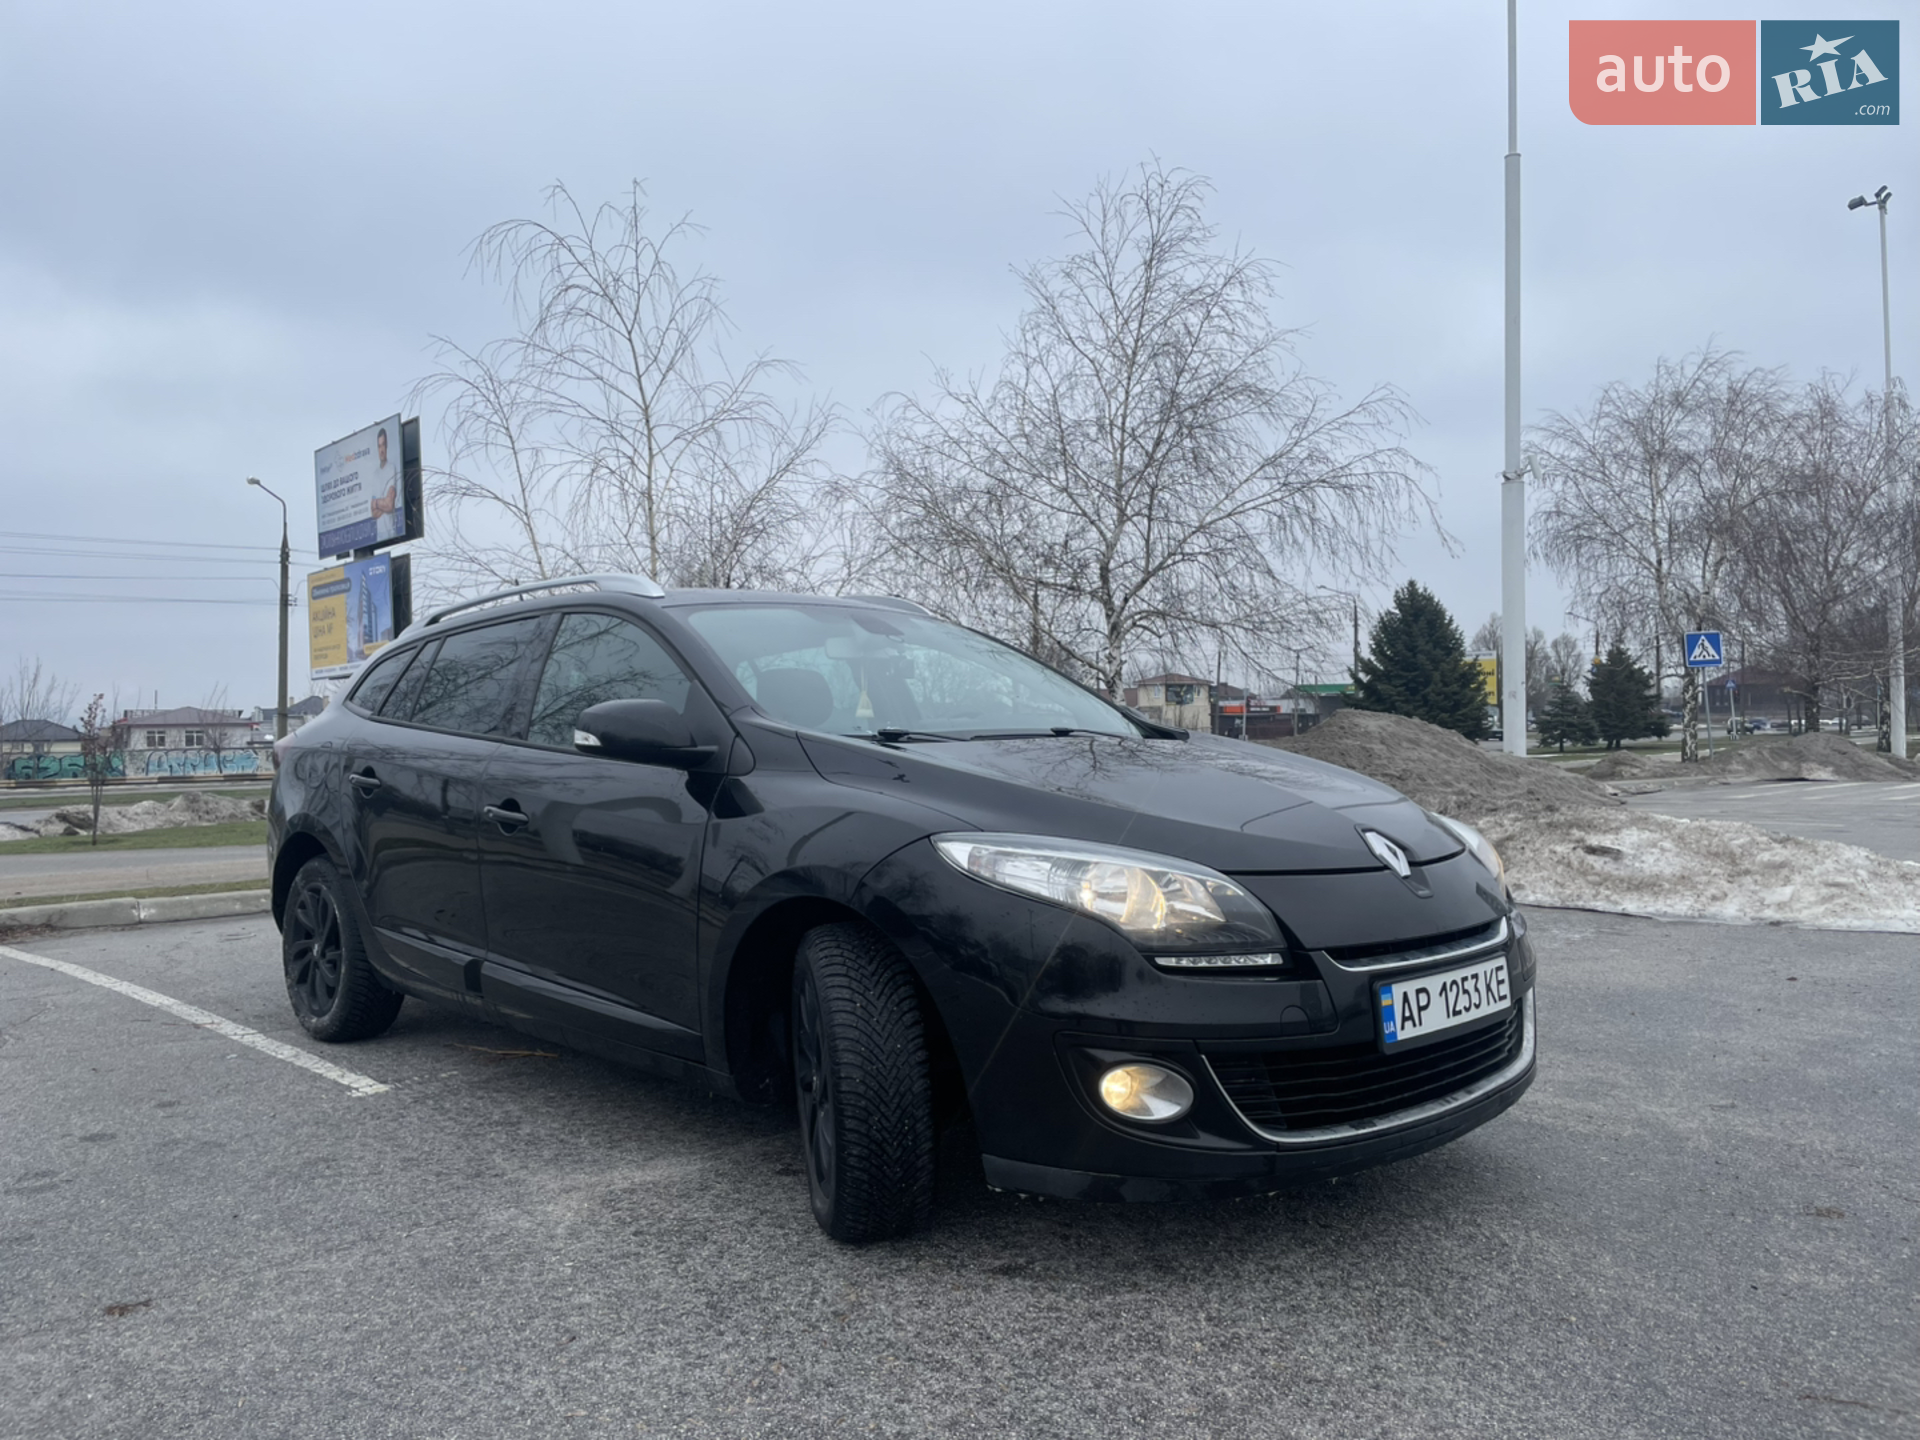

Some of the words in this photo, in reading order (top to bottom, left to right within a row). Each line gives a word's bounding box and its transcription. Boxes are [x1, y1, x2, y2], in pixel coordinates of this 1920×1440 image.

[1400, 986, 1431, 1031] AP
[1438, 972, 1482, 1019] 1253
[1484, 965, 1508, 1006] KE
[1383, 1020, 1396, 1034] UA
